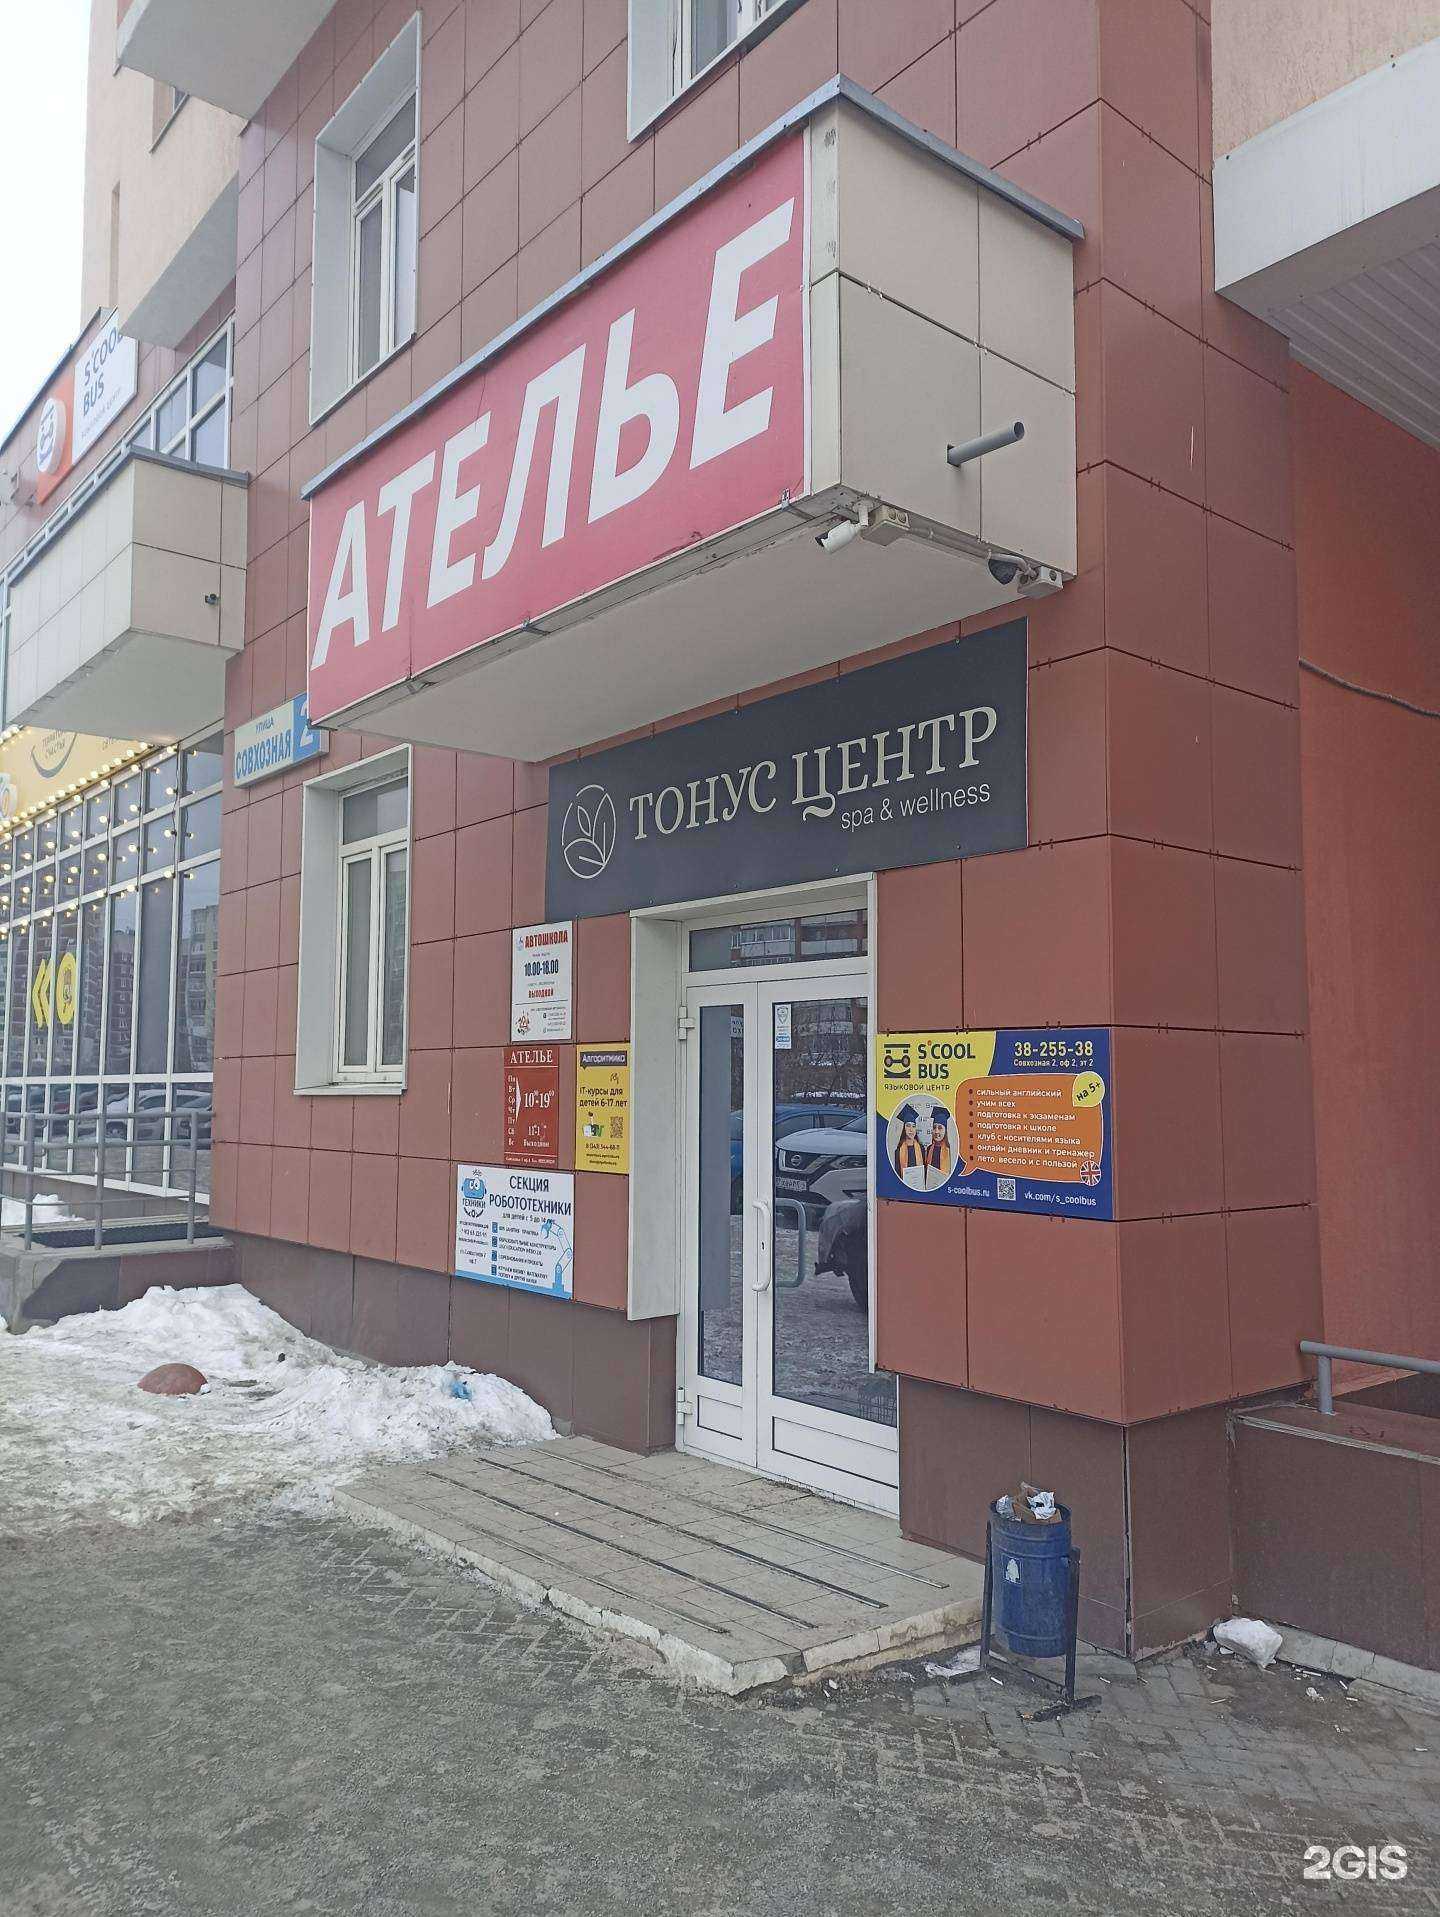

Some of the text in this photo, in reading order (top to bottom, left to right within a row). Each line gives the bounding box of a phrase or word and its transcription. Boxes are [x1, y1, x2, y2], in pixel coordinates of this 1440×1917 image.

[83, 372, 104, 416] BUS
[310, 196, 795, 671] АТЕЛЬЕ
[236, 729, 291, 779] СОВХОЗНАЯ
[630, 705, 998, 840] ТОНУС ЦЕНТР
[840, 783, 991, 832] spa & wellness
[524, 930, 568, 948] АВТОШКОЛА
[524, 958, 559, 976] 10.00-18.00
[510, 1049, 553, 1064] АТЕЛЬЕ
[918, 1040, 976, 1060] S'COOL
[1014, 1041, 1093, 1057] 38-255-38
[582, 1053, 625, 1063] Алгоритмика
[1013, 1058, 1050, 1067] Совхозная
[1059, 1058, 1070, 1068] оф
[1088, 1059, 1094, 1067] 2
[918, 1063, 950, 1079] BUS
[579, 1087, 623, 1098] IT-курсы для
[926, 1084, 950, 1092] ЦЕНТР
[976, 1088, 1062, 1098] сильный английский
[1076, 1082, 1101, 1102] на 5+
[508, 1096, 515, 1104] Ср
[579, 1098, 628, 1107] детей 6-17 лет
[977, 1111, 1021, 1119] подготовка
[1029, 1113, 1076, 1121] экзаменам
[977, 1122, 1021, 1130] подготовка
[977, 1132, 996, 1141] клуб
[1003, 1135, 1053, 1143] носителями
[977, 1144, 1006, 1152] онлайн
[1007, 1146, 1042, 1154] дневник
[1052, 1148, 1095, 1159] тренажер
[977, 1155, 995, 1163] лето
[998, 1156, 1027, 1165] весело
[1042, 1160, 1078, 1169] пользой
[510, 1175, 549, 1193] СЕКЦИЯ
[947, 1186, 990, 1197] s-coolbus.ru
[489, 1194, 571, 1216] РОБОТОТЕХНИКИ
[1024, 1191, 1097, 1206] vk.com/s_coolbus
